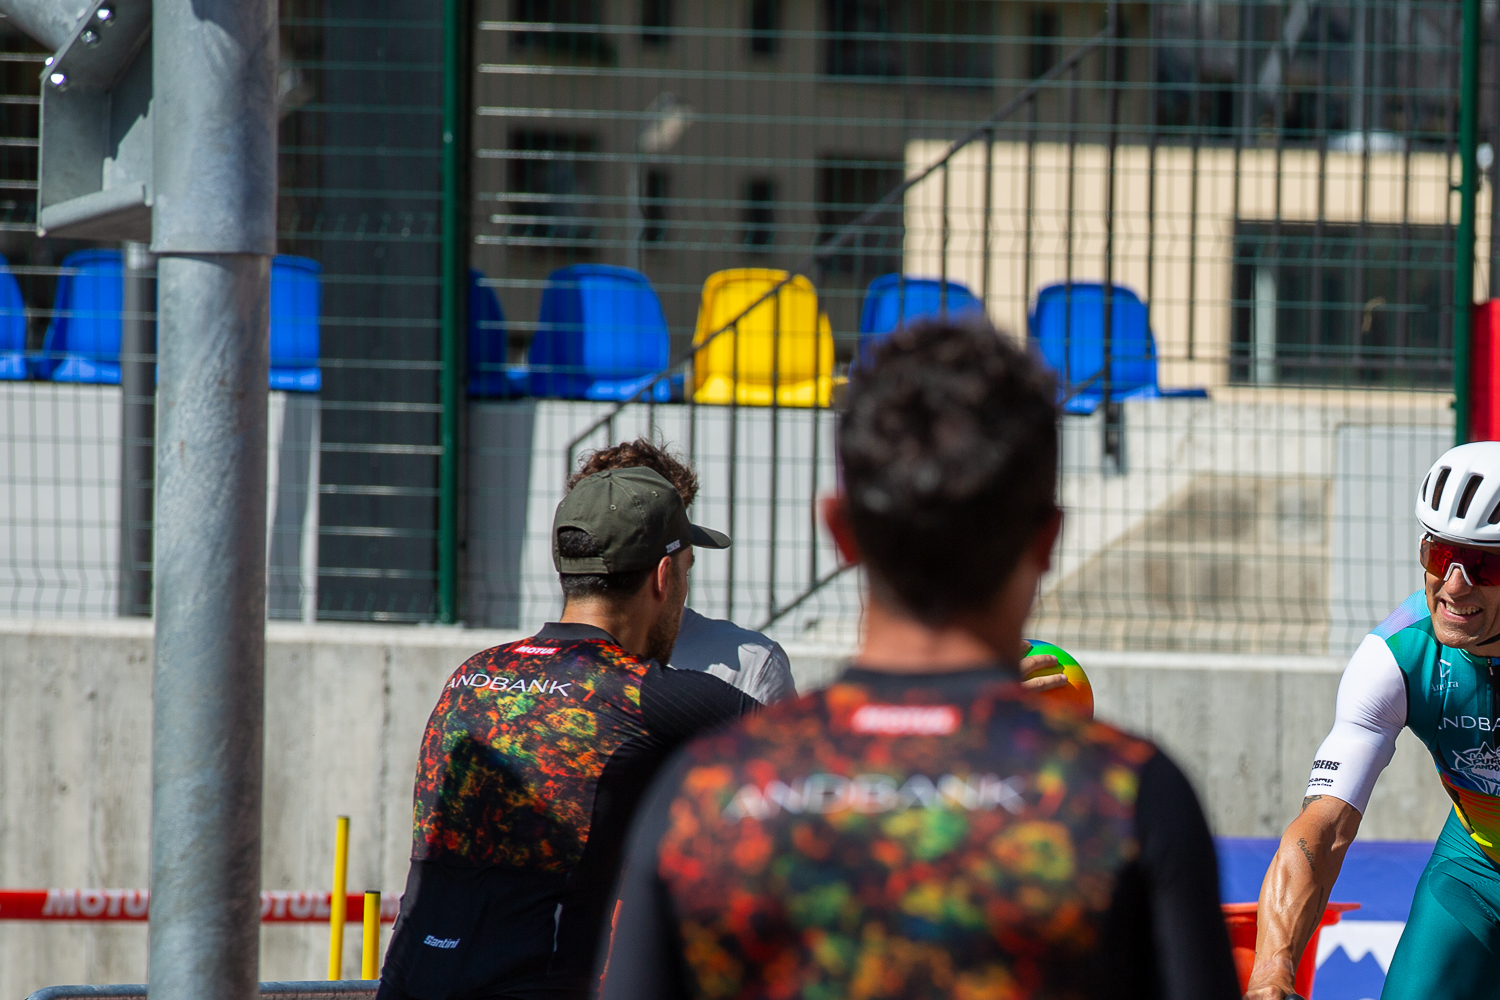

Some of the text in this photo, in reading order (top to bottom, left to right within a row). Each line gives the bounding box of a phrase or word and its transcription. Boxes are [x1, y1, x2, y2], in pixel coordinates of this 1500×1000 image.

[515, 645, 557, 655] MOTUL
[447, 673, 572, 697] ANDBANK
[42, 889, 149, 916] MOTU
[423, 934, 461, 949] Santini
